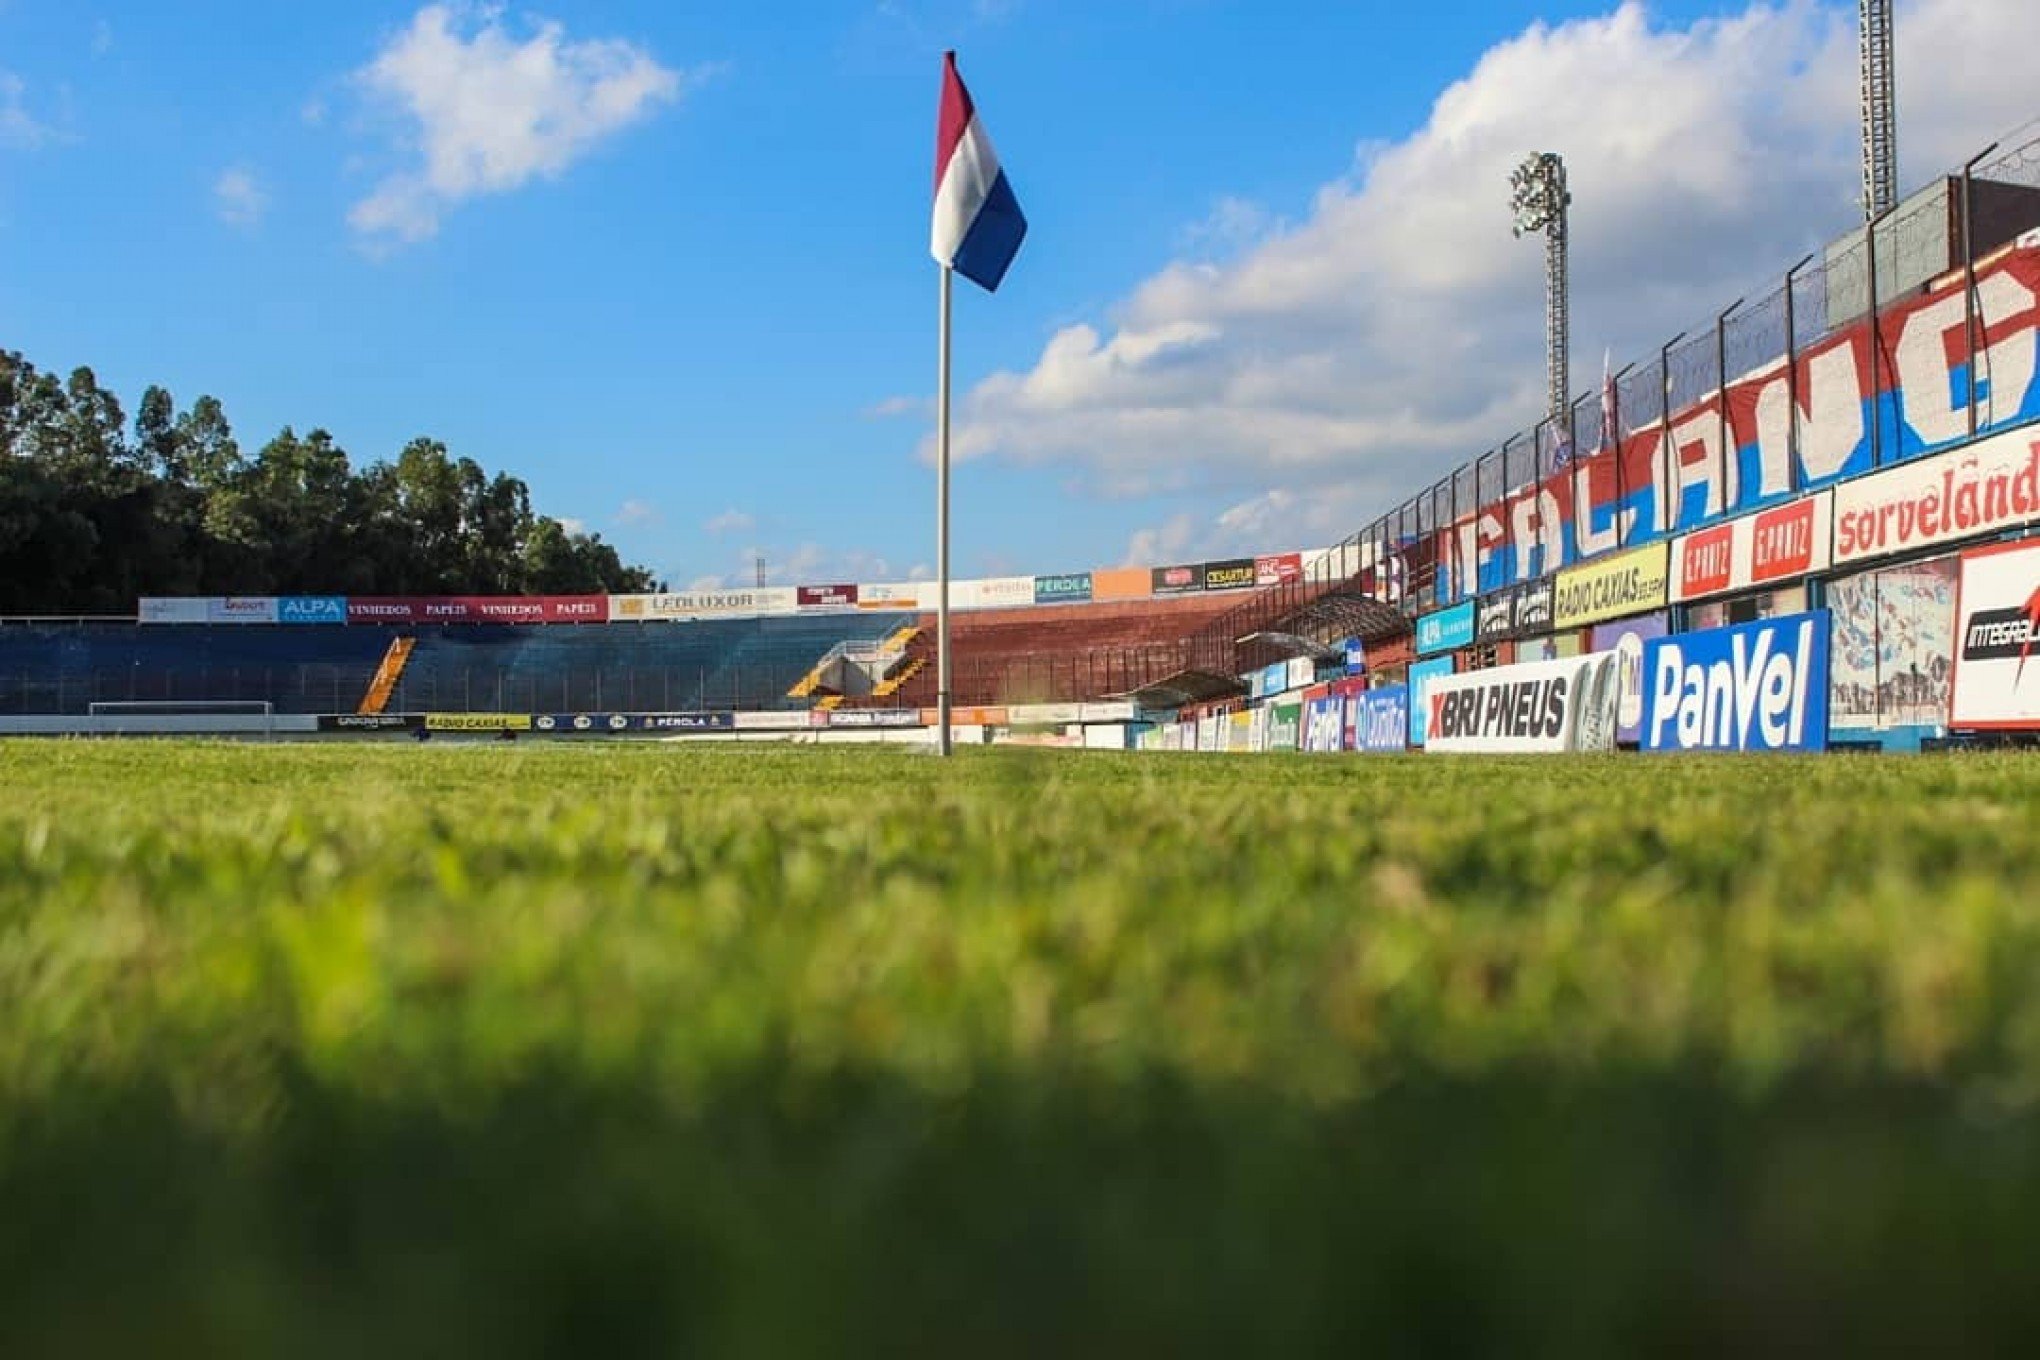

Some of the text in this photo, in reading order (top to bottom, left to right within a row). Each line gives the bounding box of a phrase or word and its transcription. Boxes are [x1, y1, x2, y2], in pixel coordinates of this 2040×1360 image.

[284, 598, 341, 614] ALPA
[1593, 566, 1639, 611] CAXIAS
[1428, 686, 1485, 741] XBRI
[1484, 676, 1568, 739] PNEUS
[1650, 620, 1814, 749] PanVel
